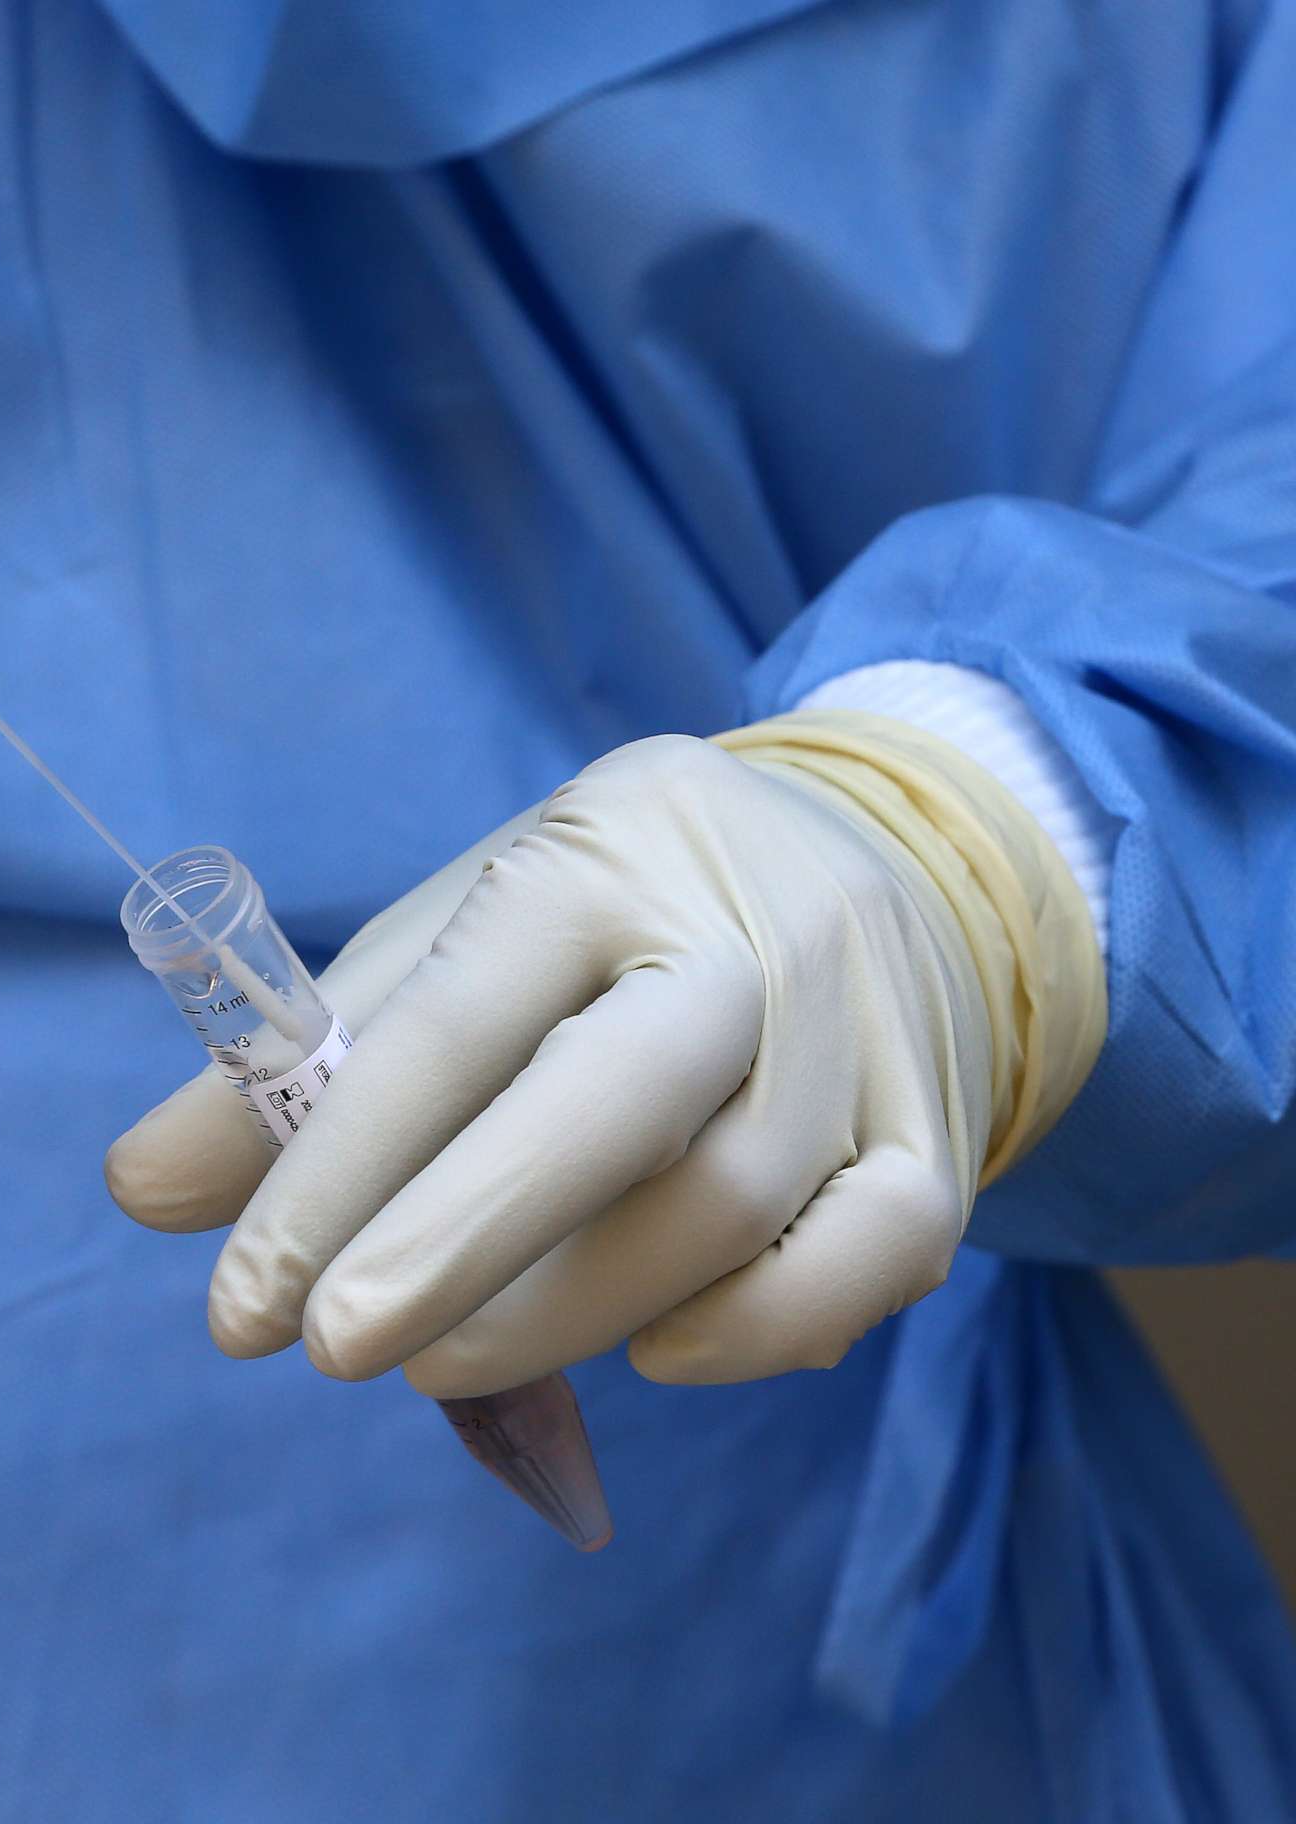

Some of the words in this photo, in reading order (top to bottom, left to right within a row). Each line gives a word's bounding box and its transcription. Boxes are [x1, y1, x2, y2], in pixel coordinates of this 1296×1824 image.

[208, 1001, 228, 1015] 14
[230, 991, 249, 1009] ml
[231, 1036, 251, 1050] 13
[251, 1068, 272, 1082] 12
